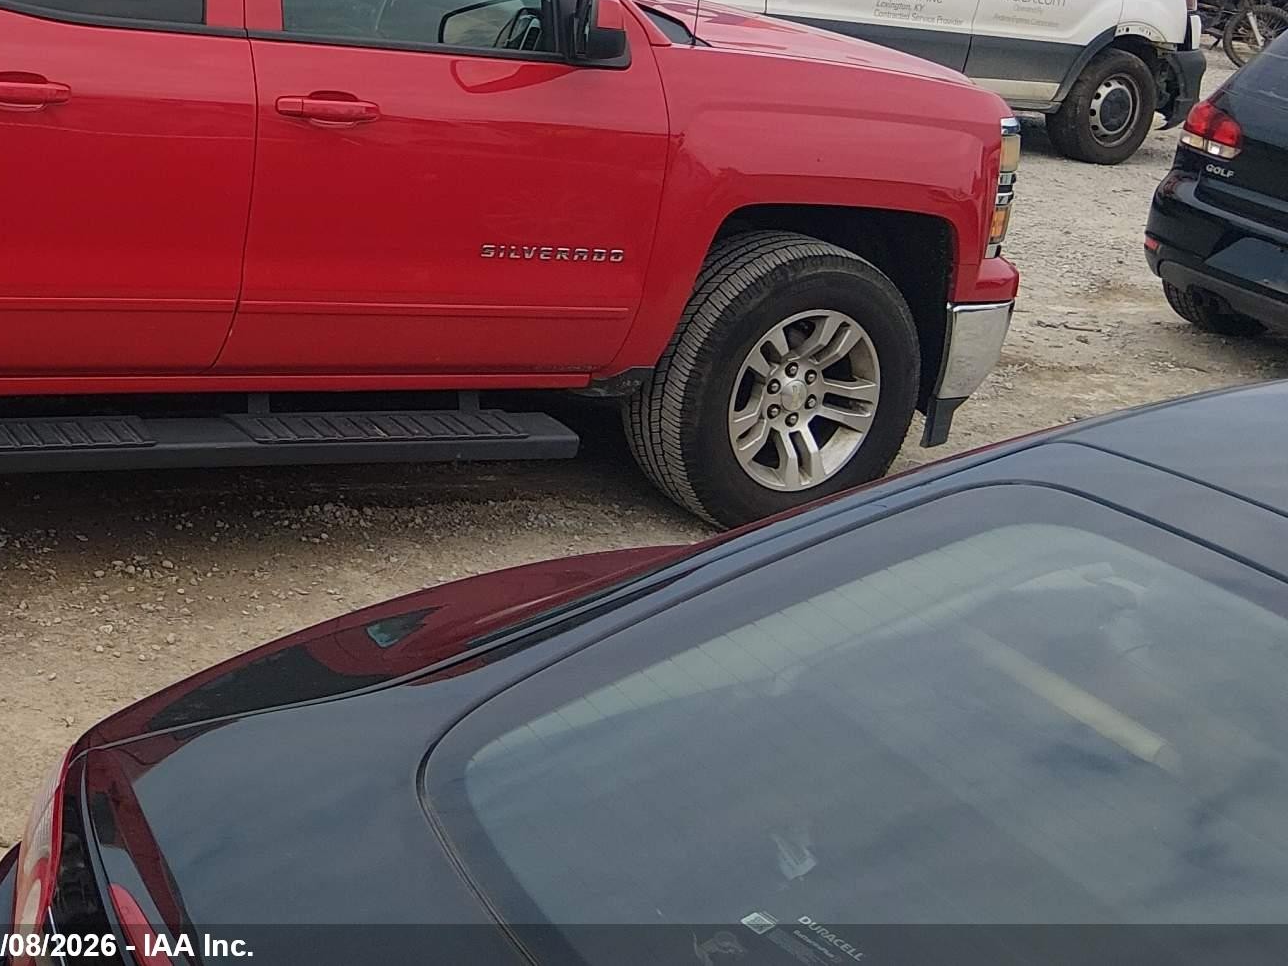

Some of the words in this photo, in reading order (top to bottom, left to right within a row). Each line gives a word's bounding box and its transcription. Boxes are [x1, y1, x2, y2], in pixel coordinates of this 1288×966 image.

[1205, 163, 1235, 178] GOLF
[480, 244, 624, 263] SILVERADO
[797, 915, 864, 962] DURACELL
